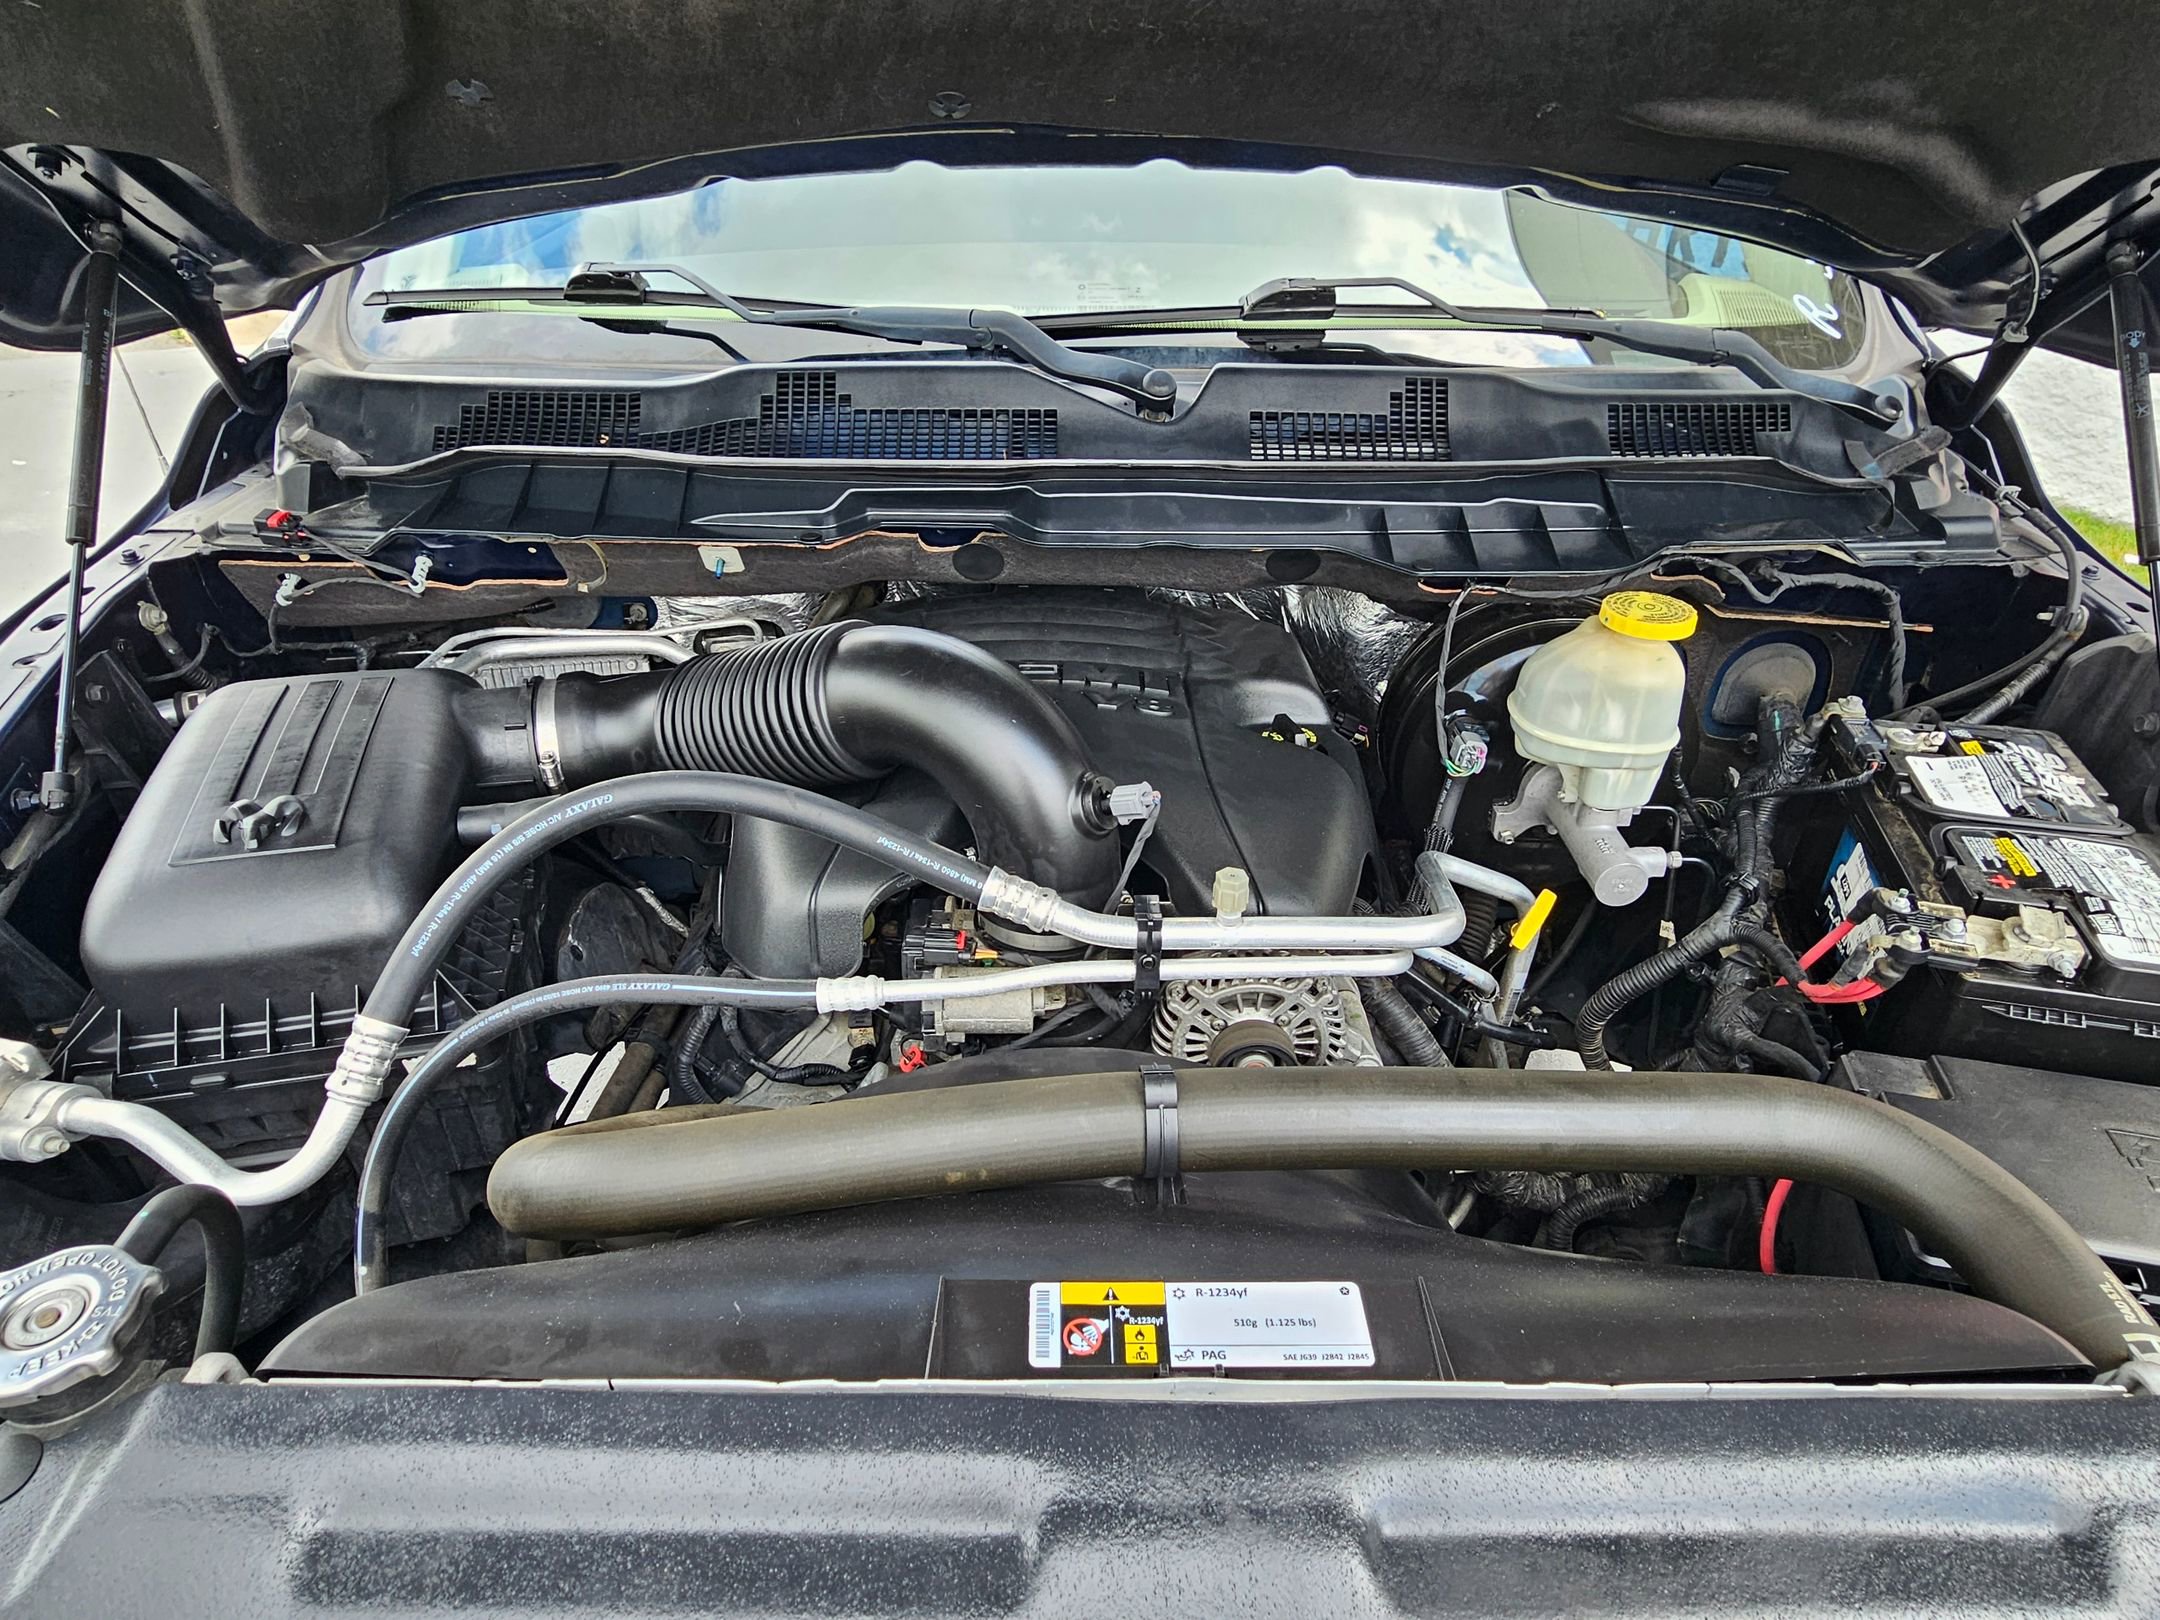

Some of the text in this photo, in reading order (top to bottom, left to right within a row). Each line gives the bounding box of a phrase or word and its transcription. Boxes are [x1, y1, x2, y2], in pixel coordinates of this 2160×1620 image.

[565, 794, 613, 818] GALAXY
[549, 813, 562, 825] A/C
[524, 820, 548, 839] HOSE
[503, 843, 514, 854] IN
[876, 836, 910, 857] R-1234yf
[490, 849, 504, 862] (16
[475, 860, 494, 876] MM)
[914, 854, 941, 871] R-134a
[941, 868, 961, 879] 4860
[459, 874, 477, 893] 4860
[436, 891, 462, 919] R-134a
[612, 983, 627, 991] SLE
[628, 982, 671, 991] GALAXY
[36, 1251, 97, 1275] OPEN
[92, 1254, 128, 1281] NOT
[109, 1277, 128, 1301] DO
[1196, 1287, 1248, 1299] R-1234yf
[91, 1305, 122, 1318] TVS
[1129, 1316, 1164, 1327] R-1234yf
[1233, 1317, 1317, 1329] 510g (1.125 lbs)
[1201, 1350, 1227, 1361] PAG
[1283, 1353, 1298, 1362] SAE
